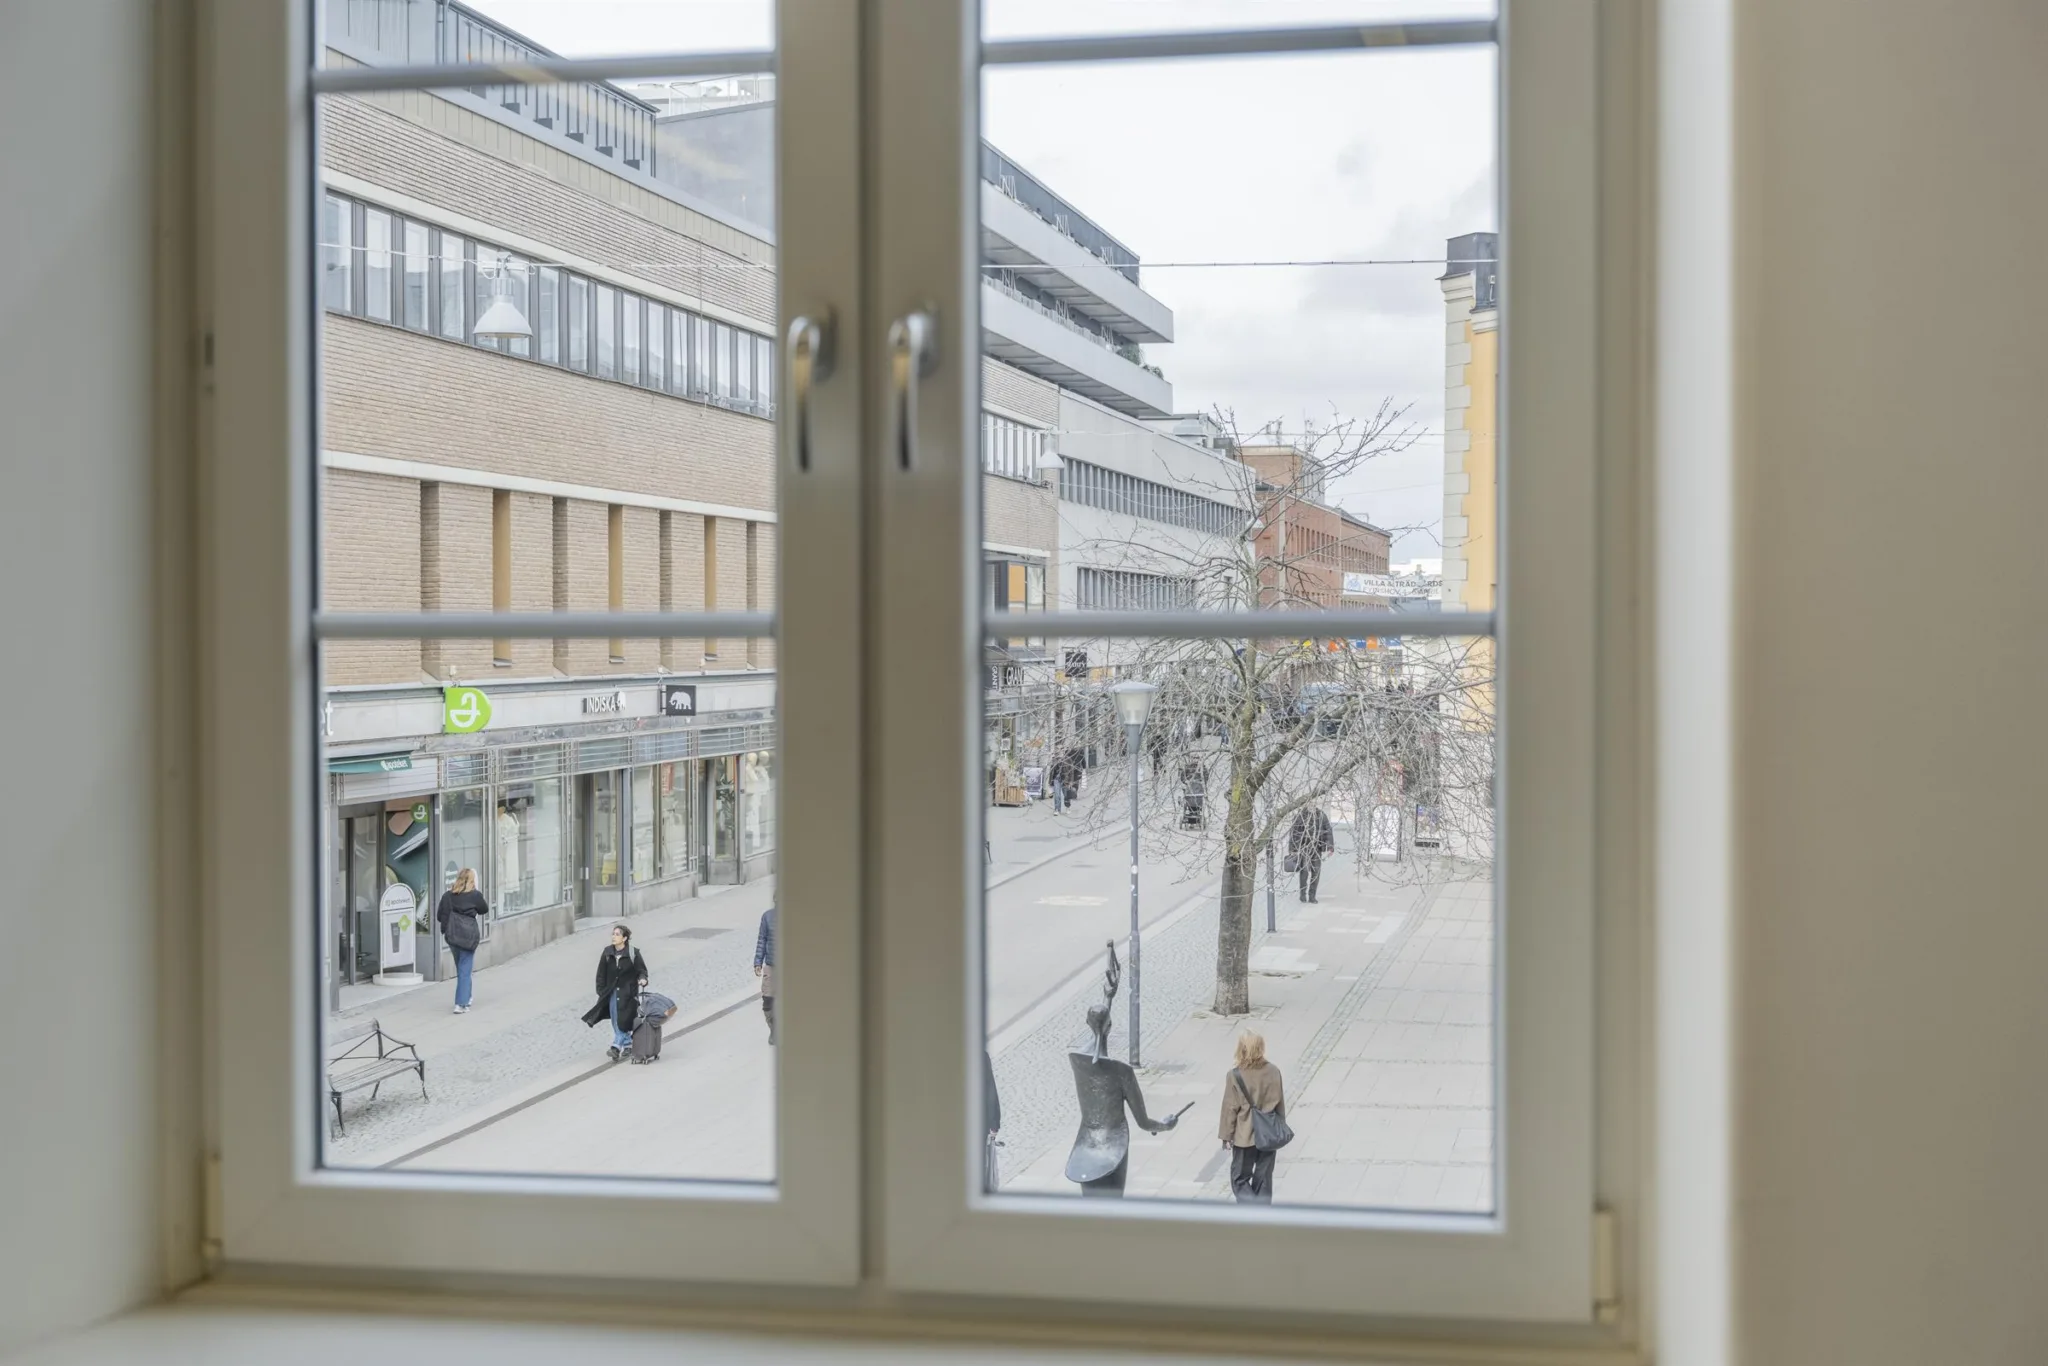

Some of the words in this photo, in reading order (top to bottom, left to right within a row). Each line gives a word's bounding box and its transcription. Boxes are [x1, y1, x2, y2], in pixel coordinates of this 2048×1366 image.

[1364, 579, 1385, 587] VILLA
[1395, 579, 1443, 588] TRÄDRDS
[586, 696, 616, 713] INDISKA
